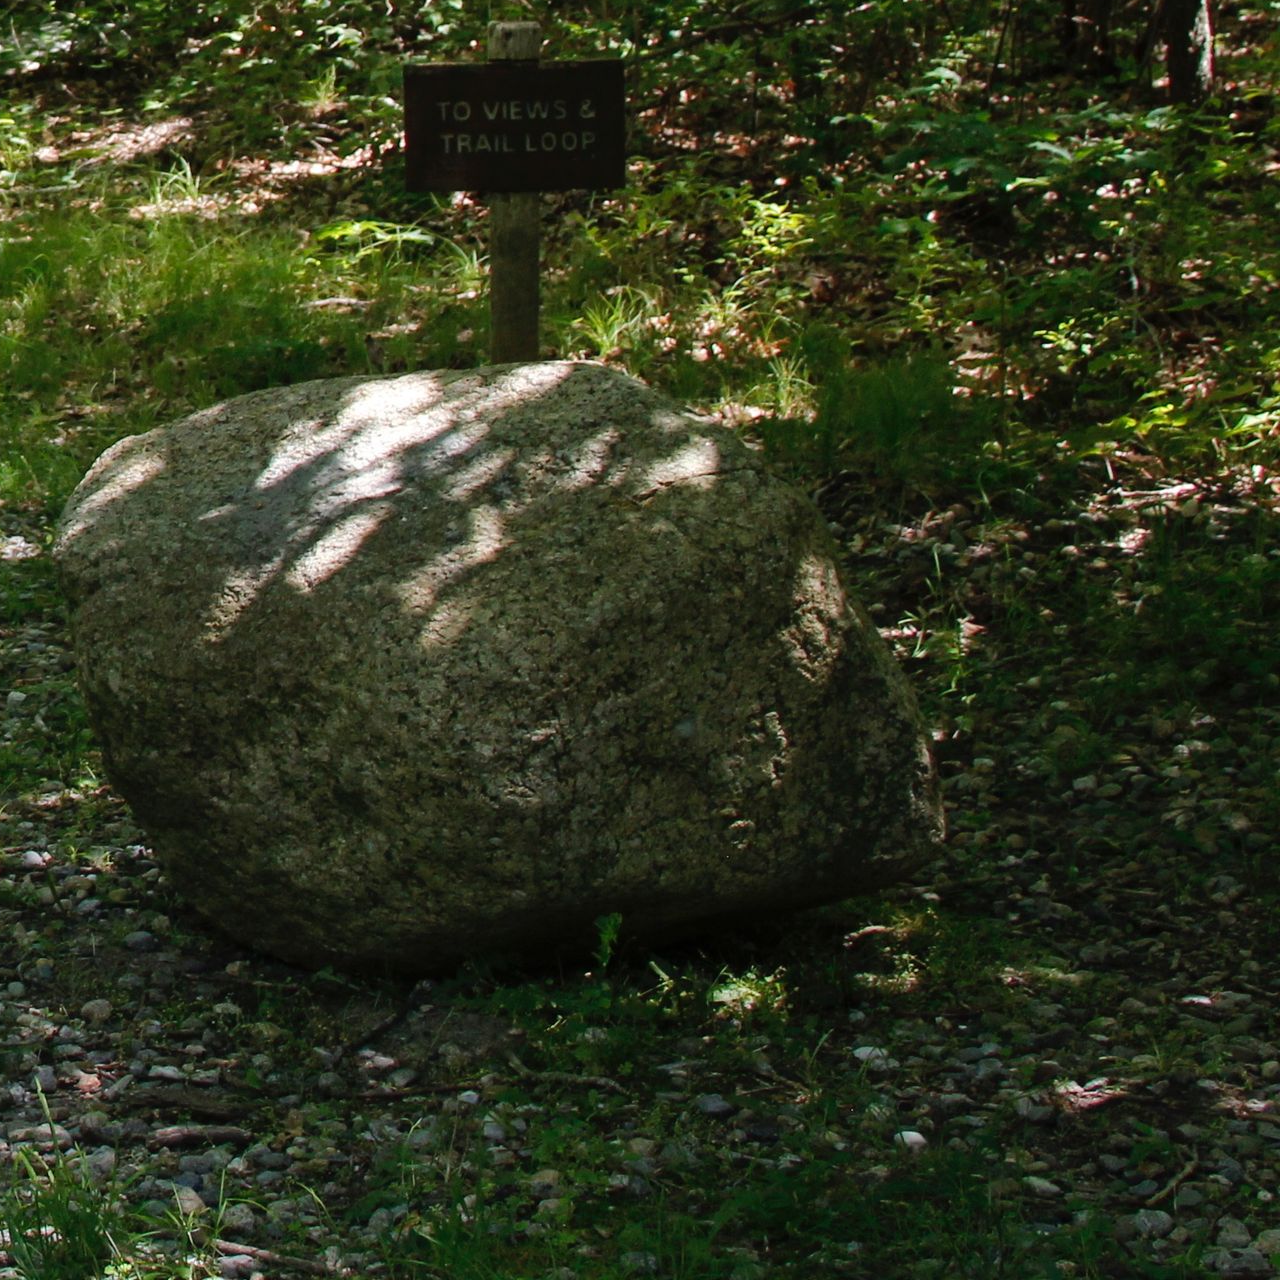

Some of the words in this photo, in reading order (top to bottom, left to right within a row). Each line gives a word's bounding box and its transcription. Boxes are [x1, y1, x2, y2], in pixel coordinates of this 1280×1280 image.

[438, 101, 472, 121] TO
[483, 100, 567, 120] VIEWS
[579, 99, 596, 119] &
[442, 133, 515, 153] TRAIL
[525, 131, 596, 152] LOOP
